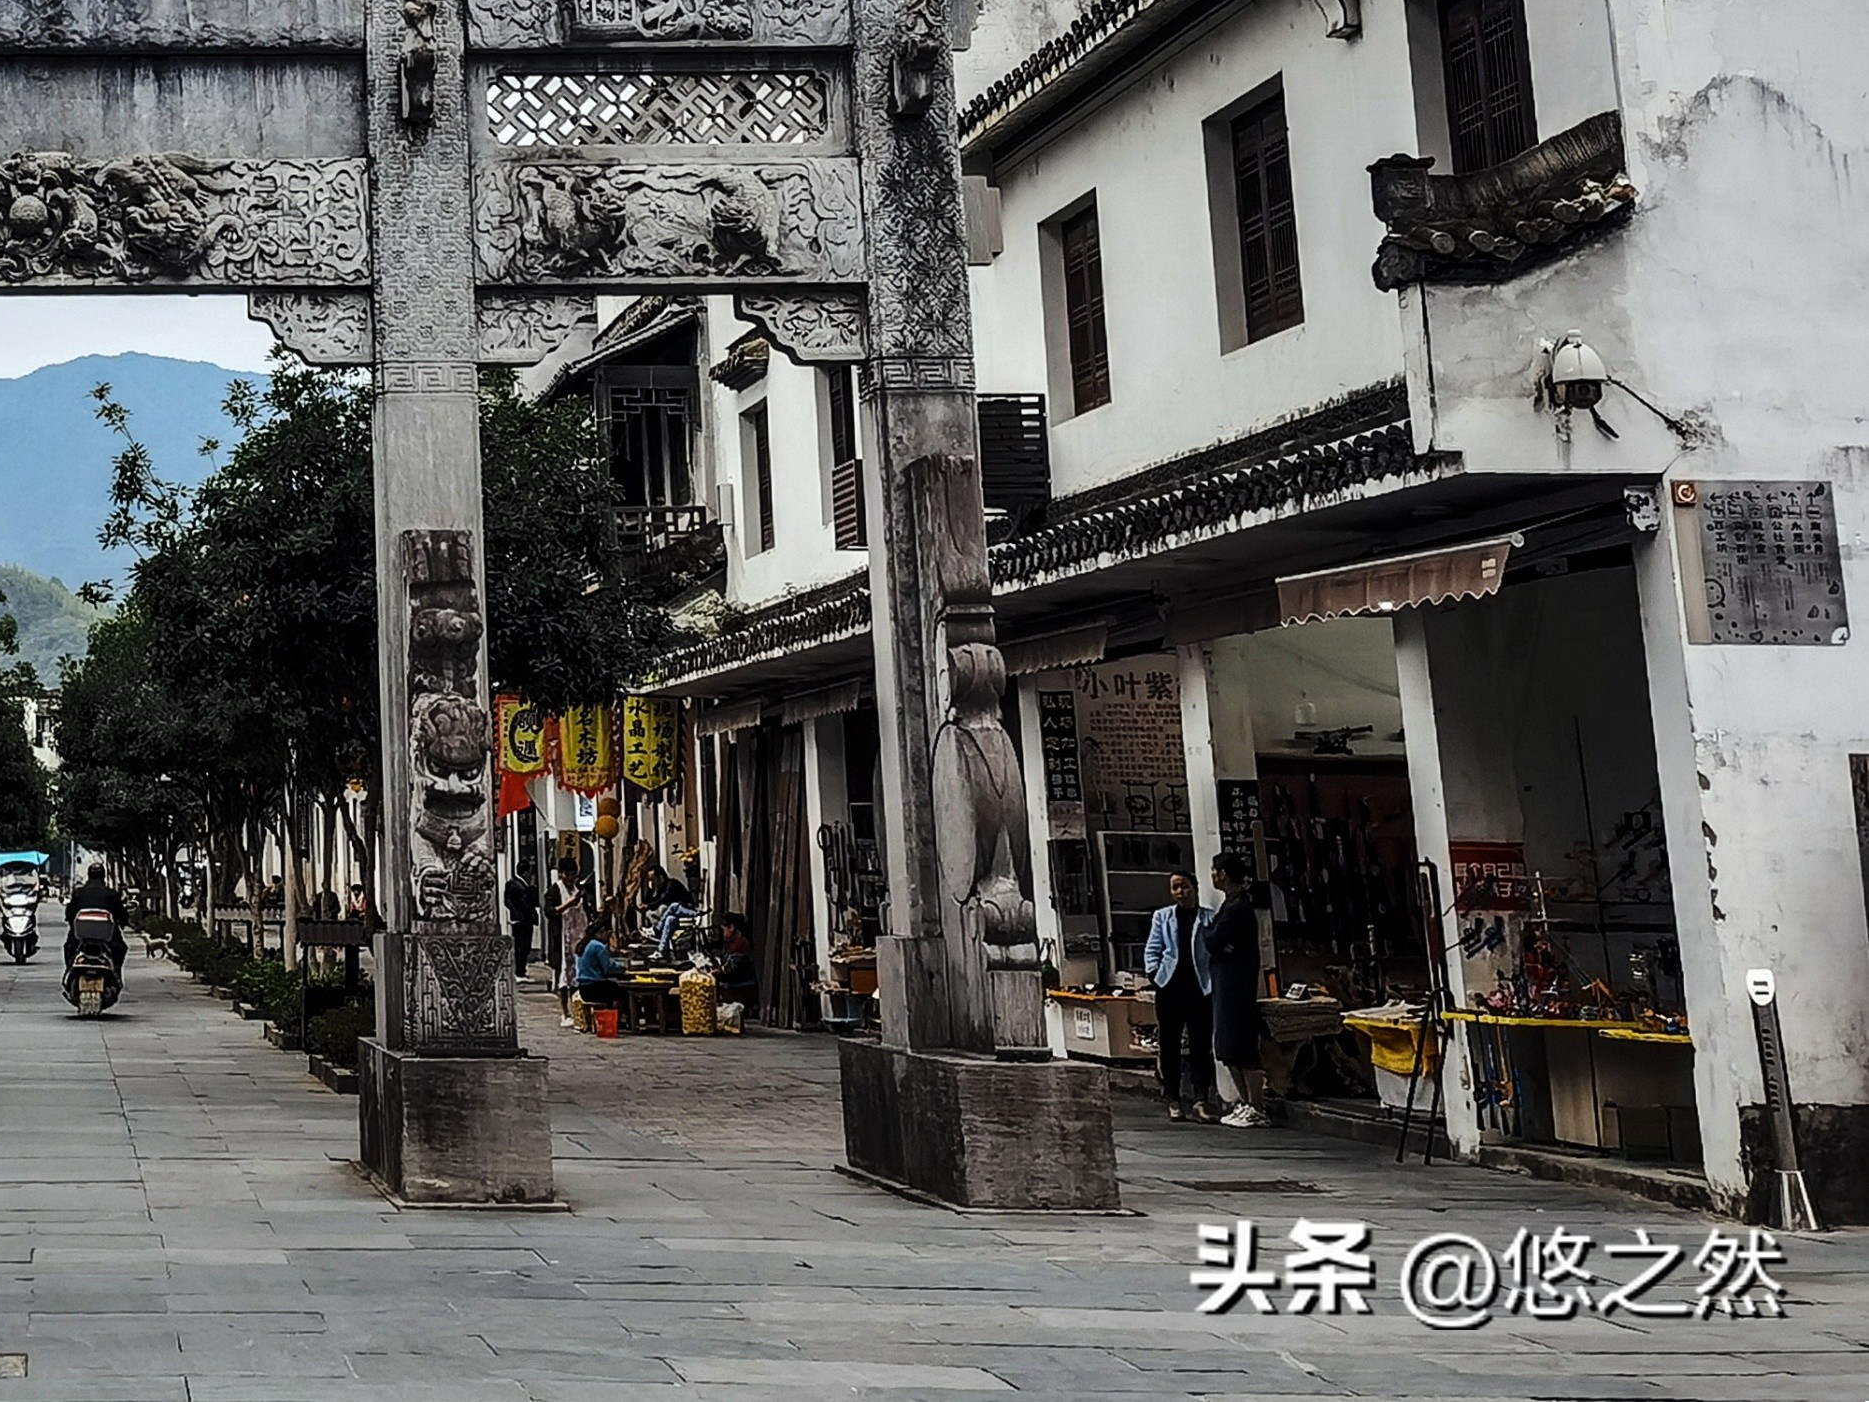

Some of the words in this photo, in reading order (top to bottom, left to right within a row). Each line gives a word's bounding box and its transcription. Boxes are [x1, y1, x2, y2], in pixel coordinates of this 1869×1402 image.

[1080, 670, 1181, 700] 小叶紫
[627, 700, 649, 779] 水晶工艺
